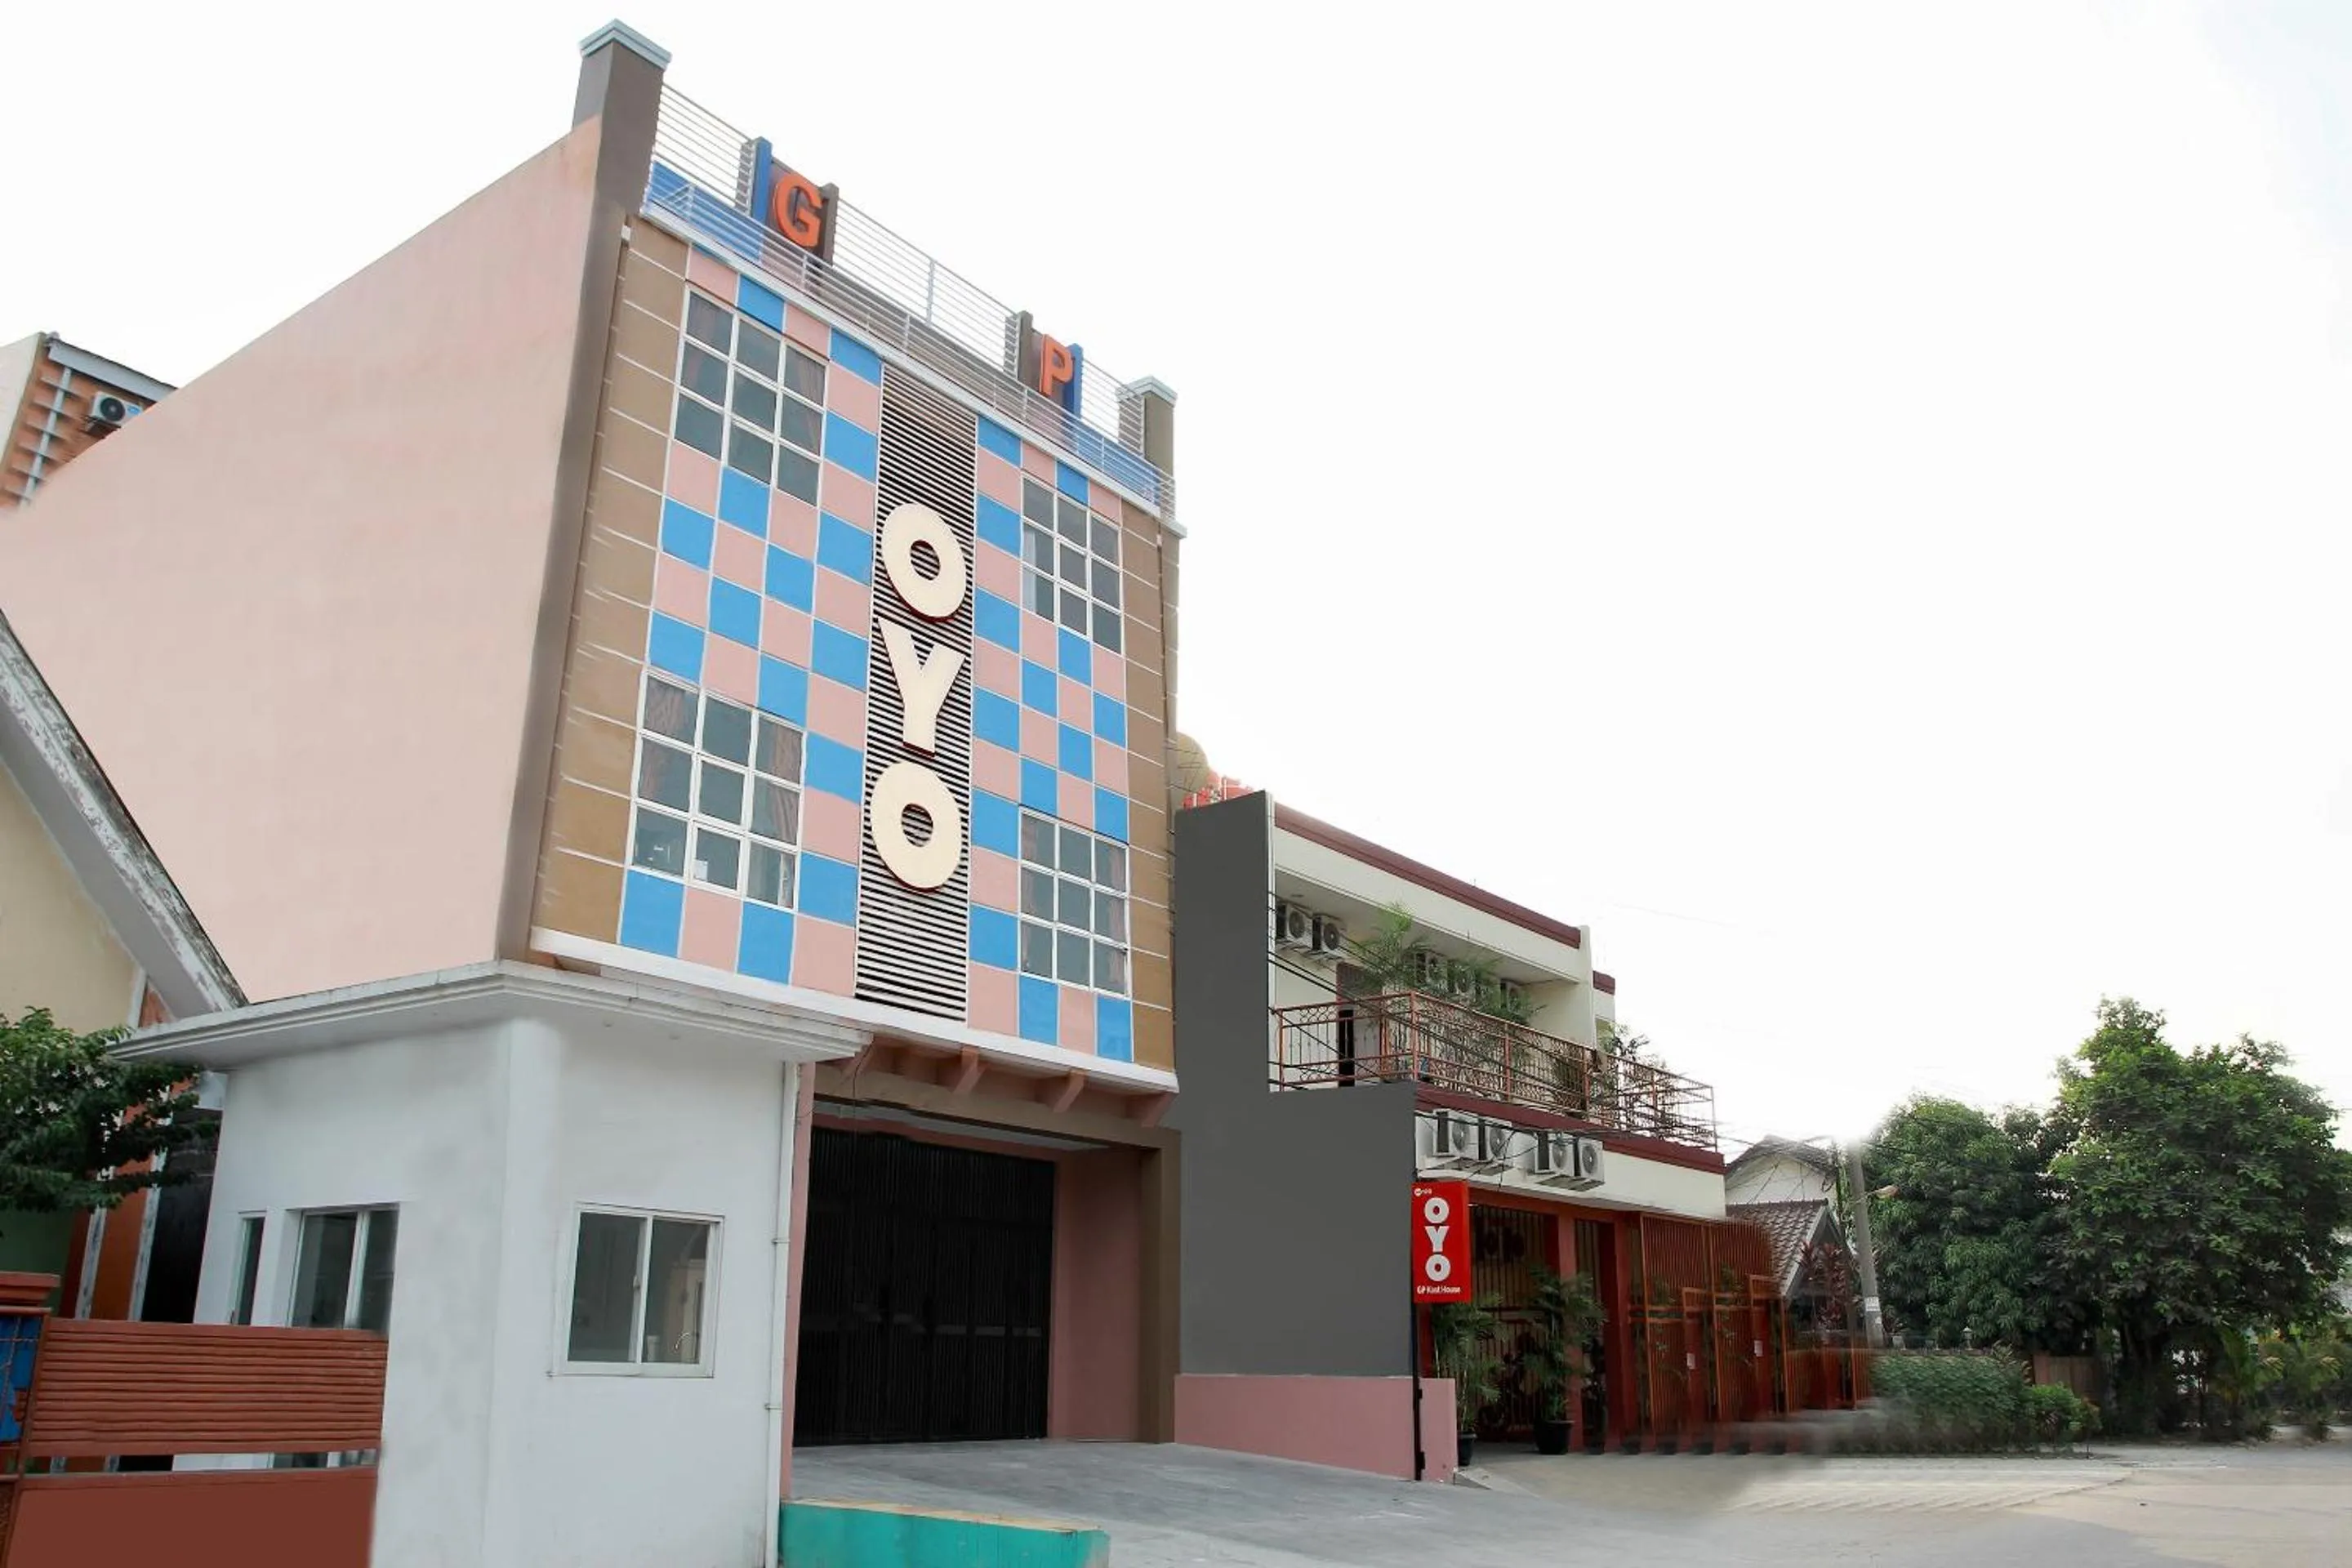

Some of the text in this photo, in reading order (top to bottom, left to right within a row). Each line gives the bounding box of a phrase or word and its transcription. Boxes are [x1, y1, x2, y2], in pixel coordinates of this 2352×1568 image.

[773, 172, 1072, 396] G P
[870, 502, 966, 892] OYO
[1424, 1197, 1451, 1282] OYO
